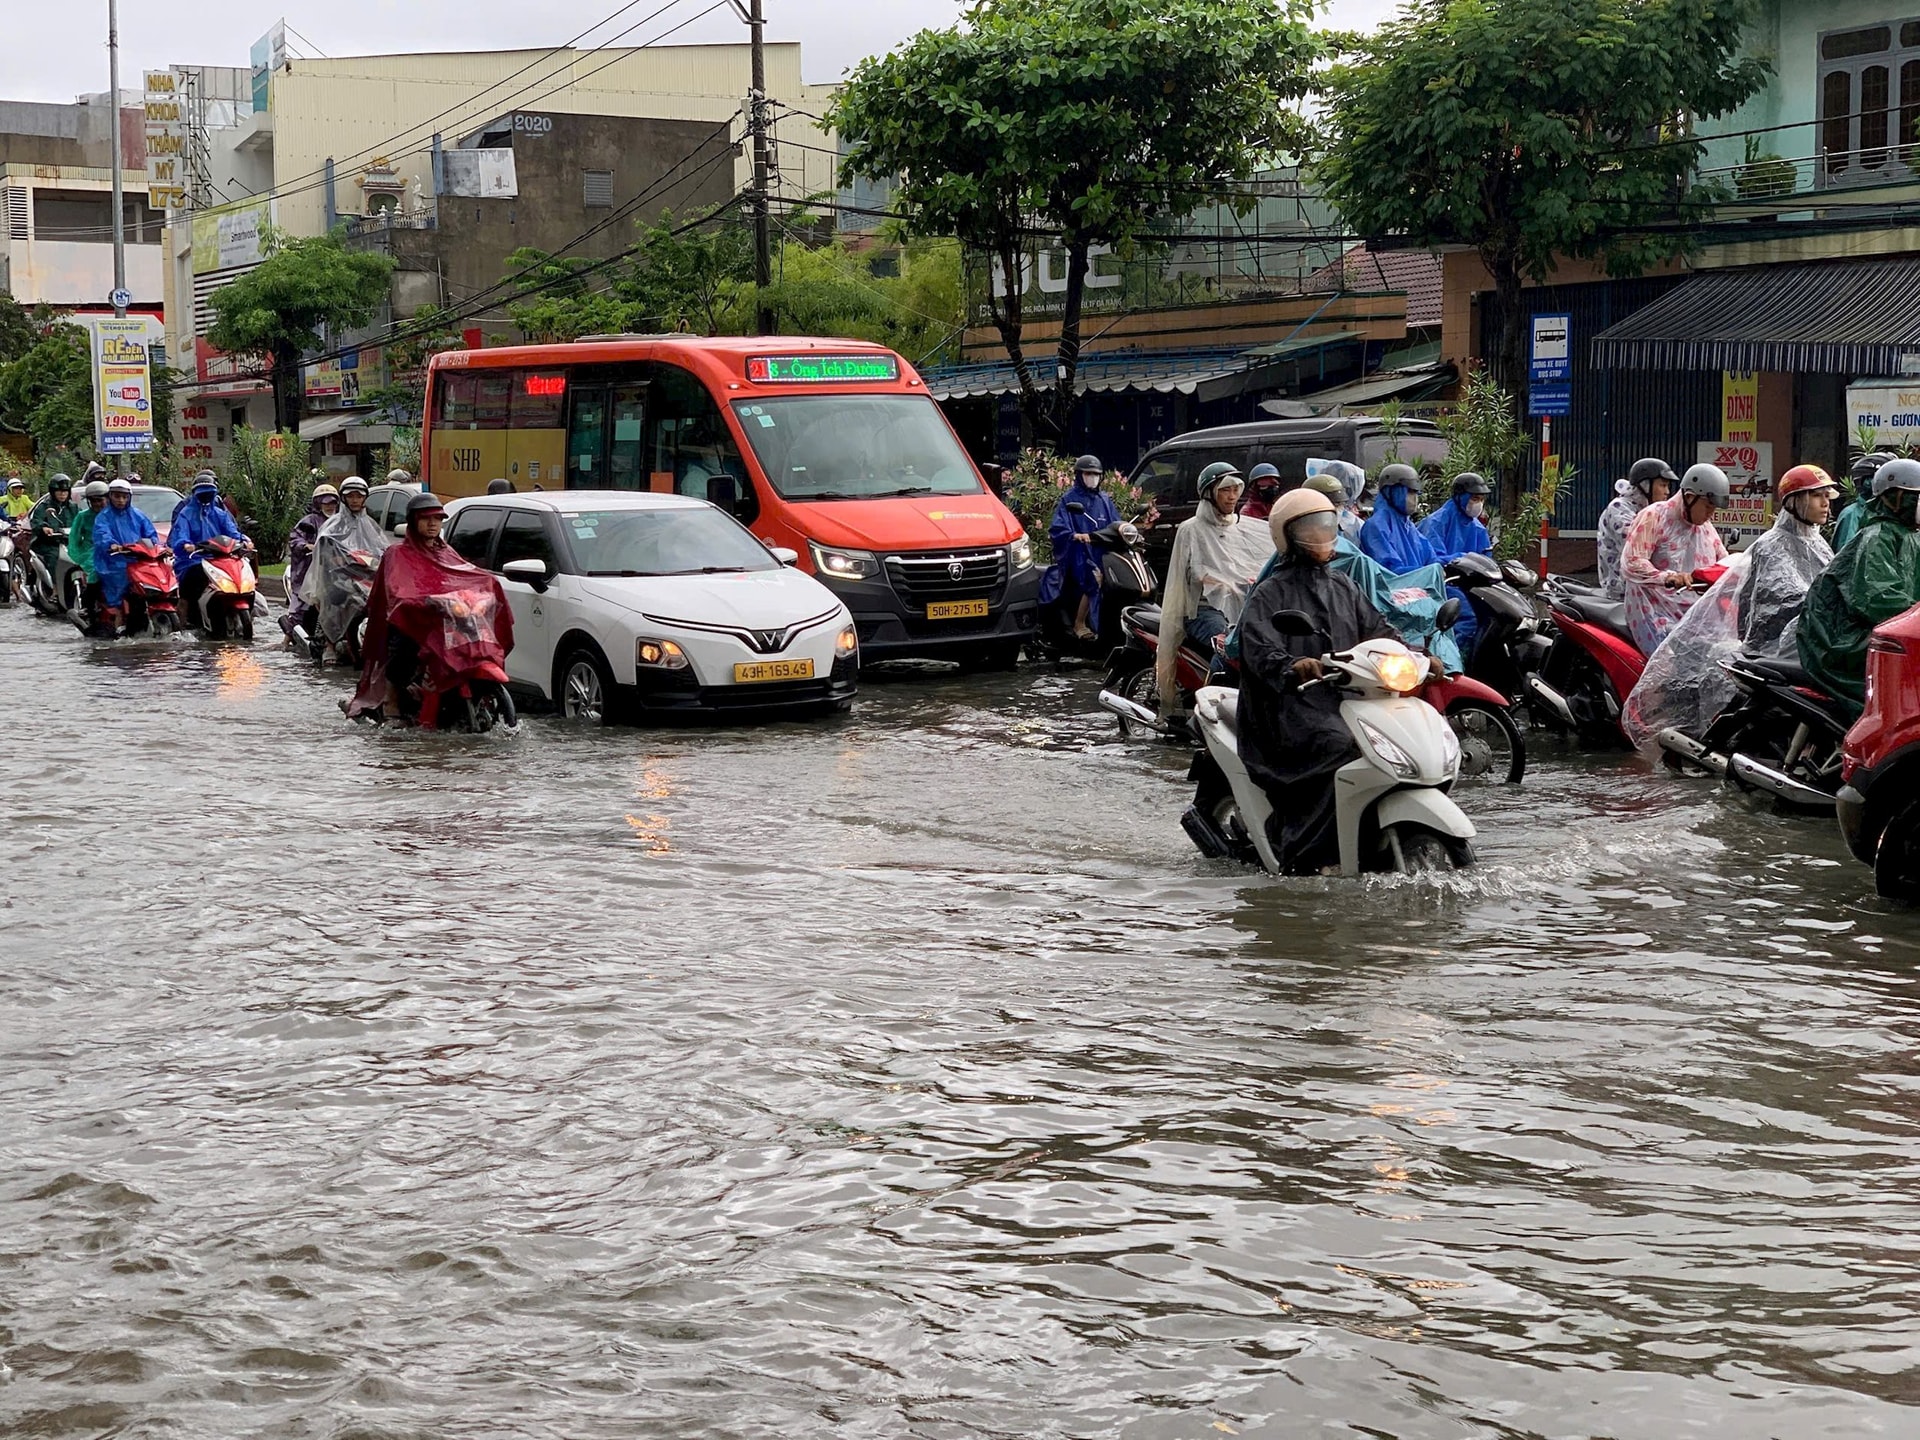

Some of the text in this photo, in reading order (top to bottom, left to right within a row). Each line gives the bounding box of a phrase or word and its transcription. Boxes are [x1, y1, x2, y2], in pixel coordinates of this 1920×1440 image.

[147, 74, 175, 92] NHA
[145, 103, 180, 120] KHOA
[514, 114, 552, 131] 2020
[155, 159, 175, 180] MỸ
[149, 186, 185, 208] 175
[750, 361, 767, 378] 21
[791, 357, 819, 379] Ông
[820, 357, 844, 377] Ích
[845, 361, 888, 378] Đường
[109, 389, 139, 398] You Tube
[1858, 411, 1881, 426] ĐÈN
[453, 448, 480, 472] SHB
[1722, 511, 1745, 522] MÁY
[932, 603, 983, 617] 50H-275.15
[742, 662, 807, 679] 43H-169.49
